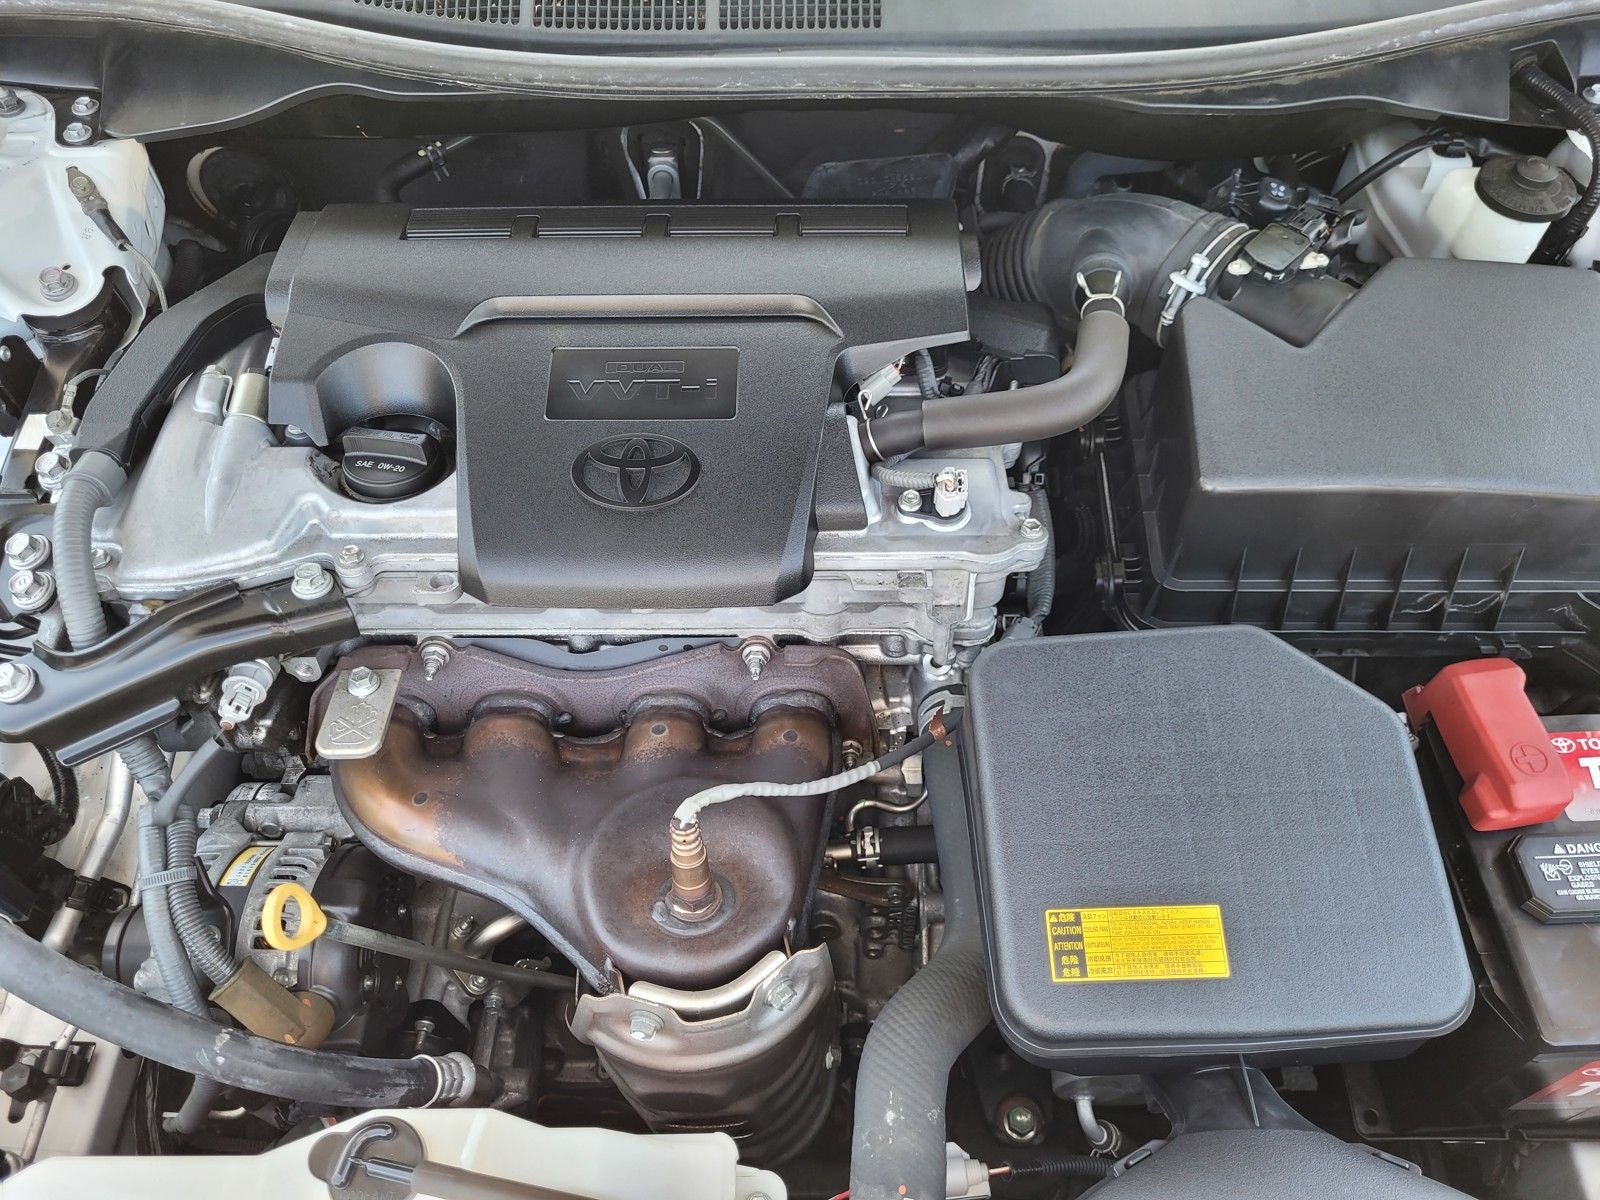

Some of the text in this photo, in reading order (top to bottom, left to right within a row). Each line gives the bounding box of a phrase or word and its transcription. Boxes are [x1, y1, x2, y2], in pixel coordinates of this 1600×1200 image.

[567, 378, 718, 401] VVT-i
[355, 460, 406, 473] SAE 0W-20
[1051, 926, 1082, 935] CAUTION
[1054, 941, 1084, 951] ATTENTION
